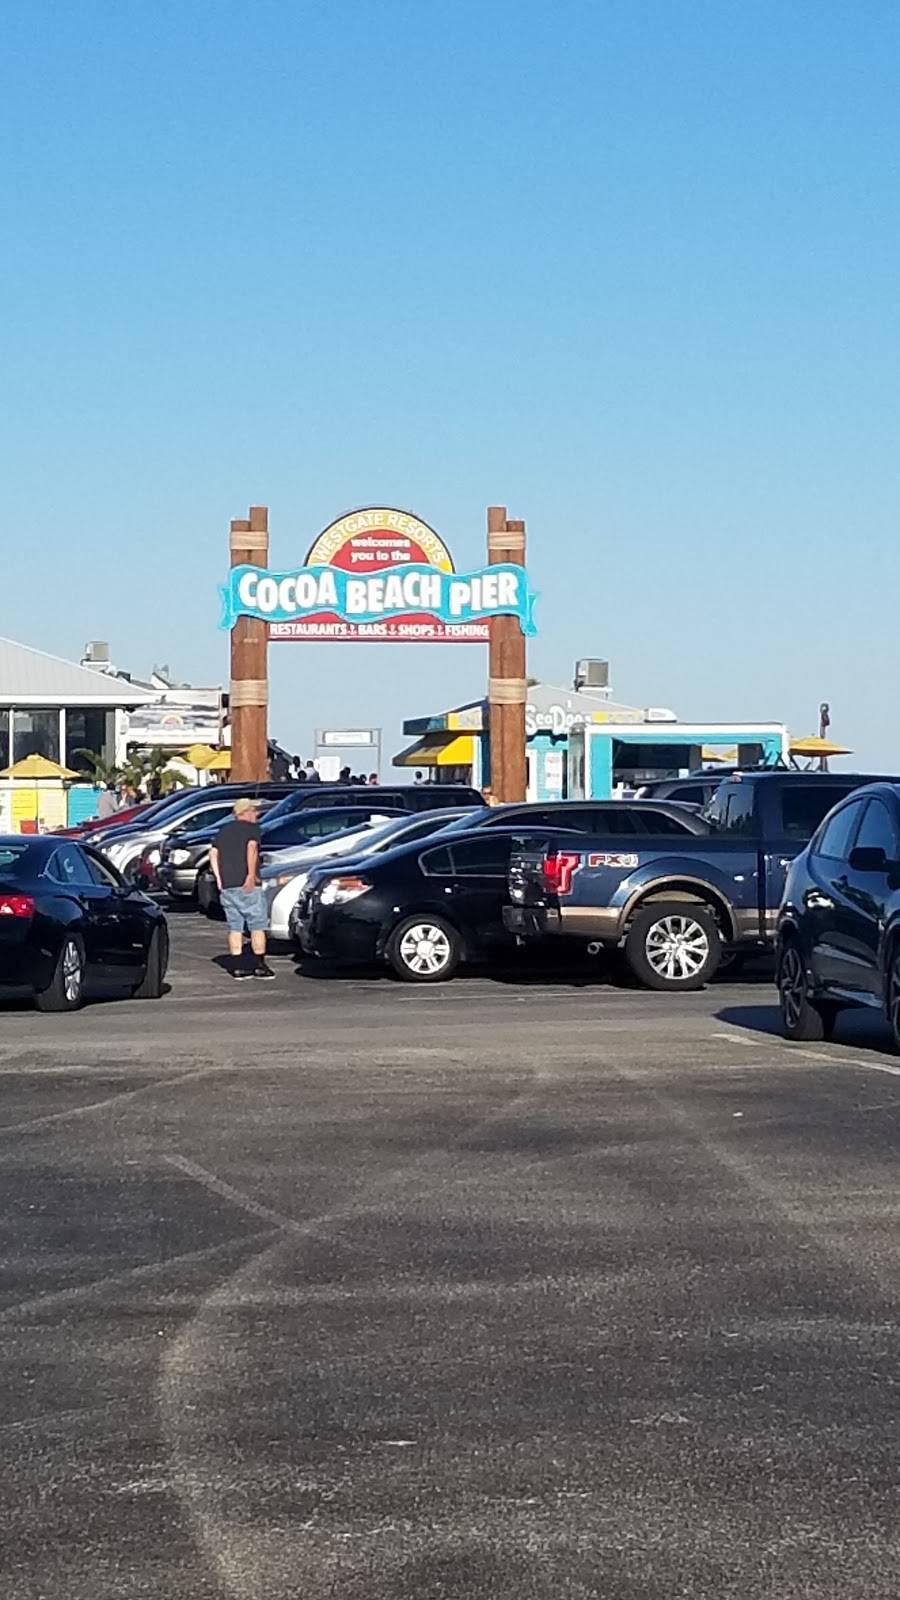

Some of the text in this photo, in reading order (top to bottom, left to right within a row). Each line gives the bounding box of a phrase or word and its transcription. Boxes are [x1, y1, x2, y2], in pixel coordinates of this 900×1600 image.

[315, 512, 446, 561] WESTGATE RESORTS
[351, 537, 411, 548] welcomes
[351, 550, 411, 563] you to the
[239, 571, 519, 615] COCOA BEACH PIER
[269, 623, 490, 637] RESTAURANTS BARS SHOPS FISHING
